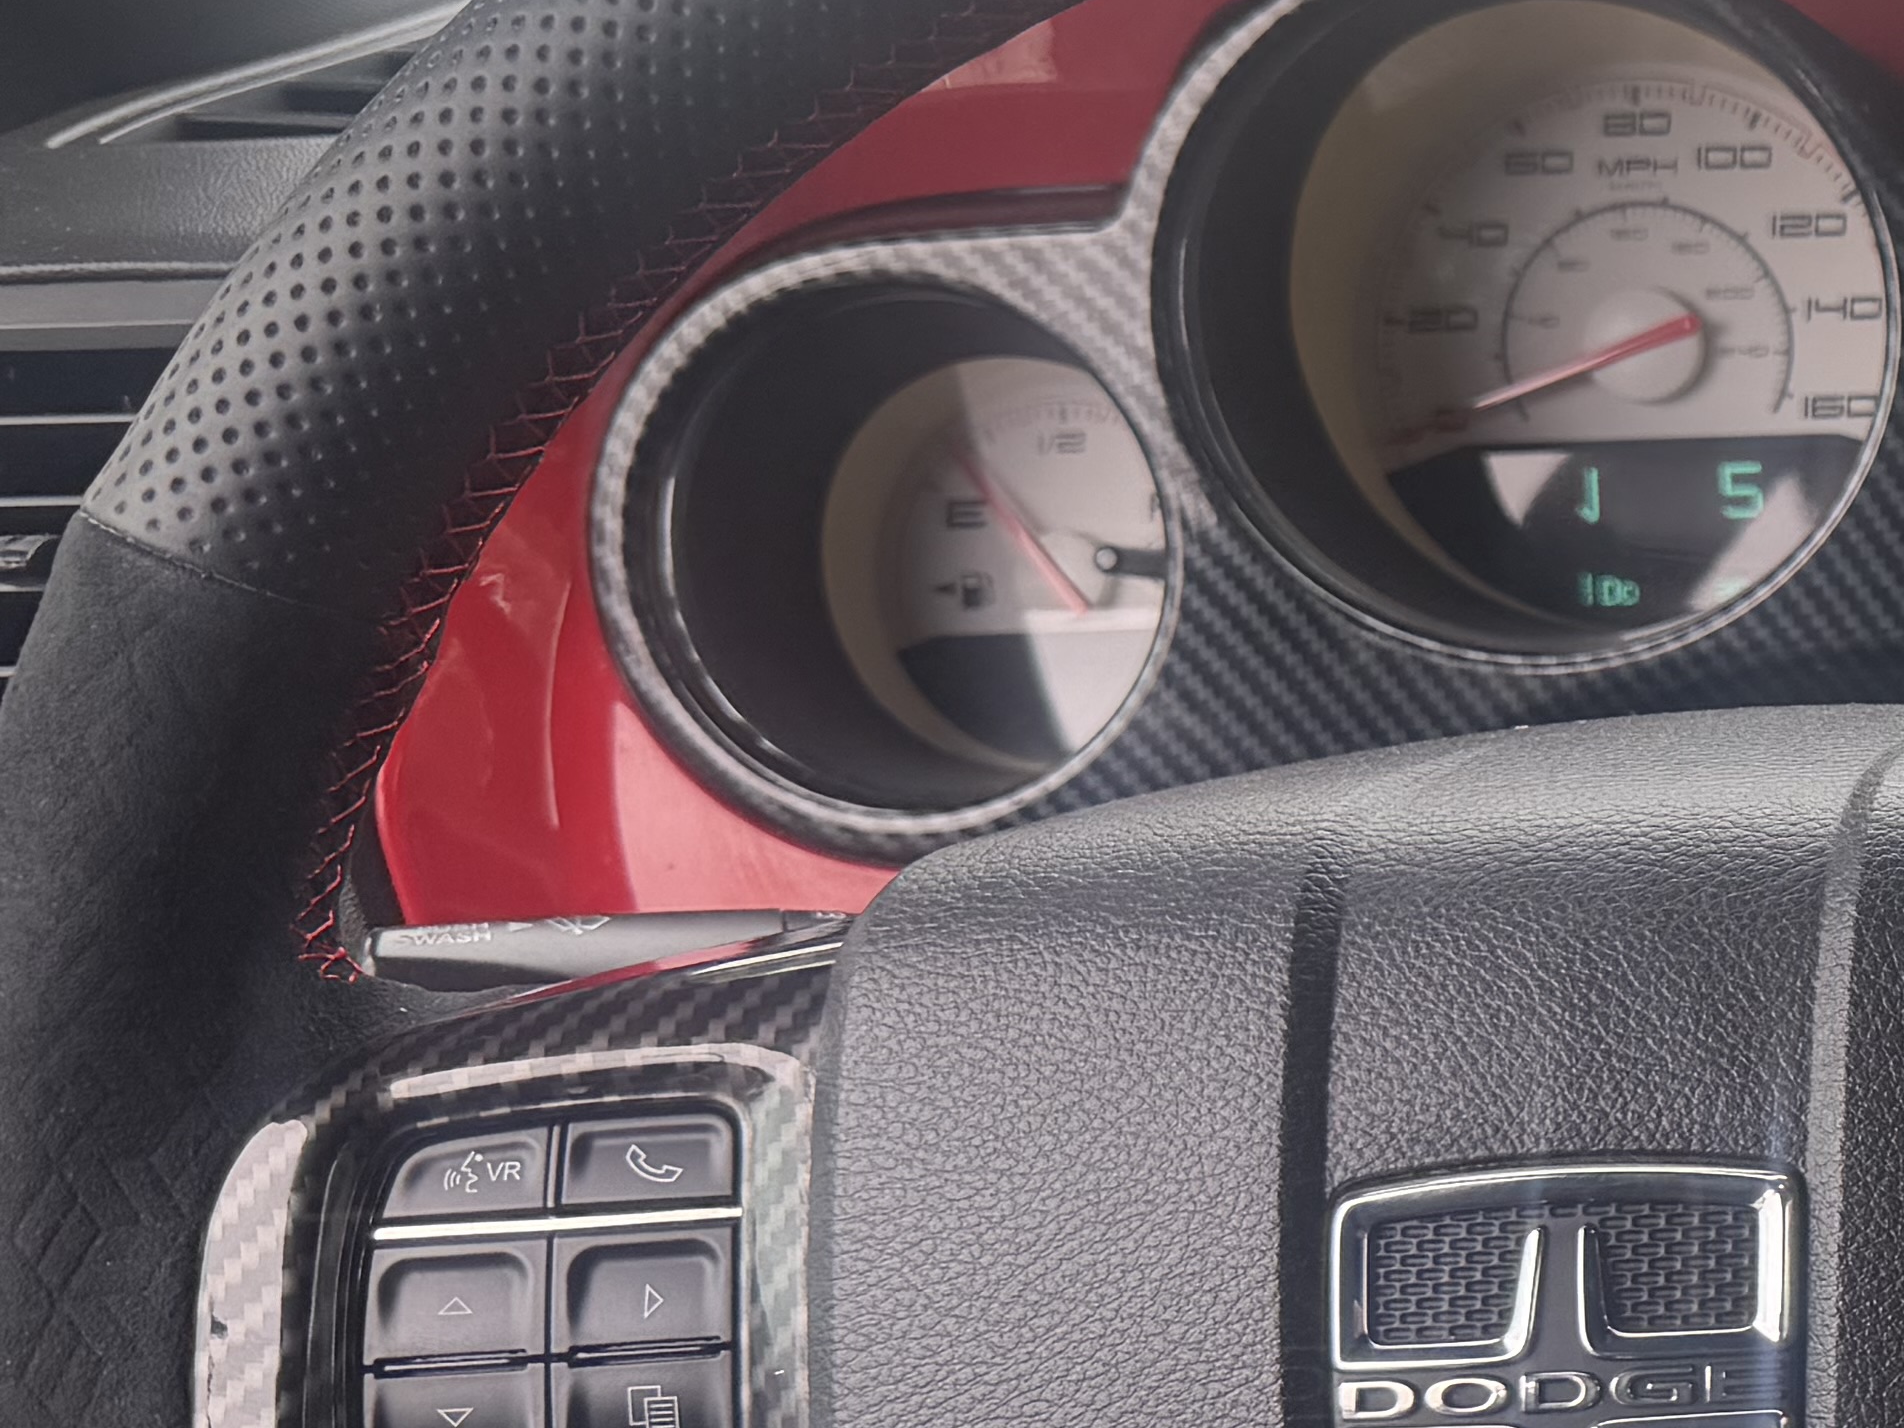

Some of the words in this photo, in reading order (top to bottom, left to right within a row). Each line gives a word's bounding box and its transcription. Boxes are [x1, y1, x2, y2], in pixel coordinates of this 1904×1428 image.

[1597, 157, 1679, 178] MPH
[1697, 145, 1772, 170] 100
[1773, 213, 1847, 237] 120
[1808, 296, 1883, 320] 140
[1804, 396, 1877, 418] 160
[486, 1160, 521, 1182] VR
